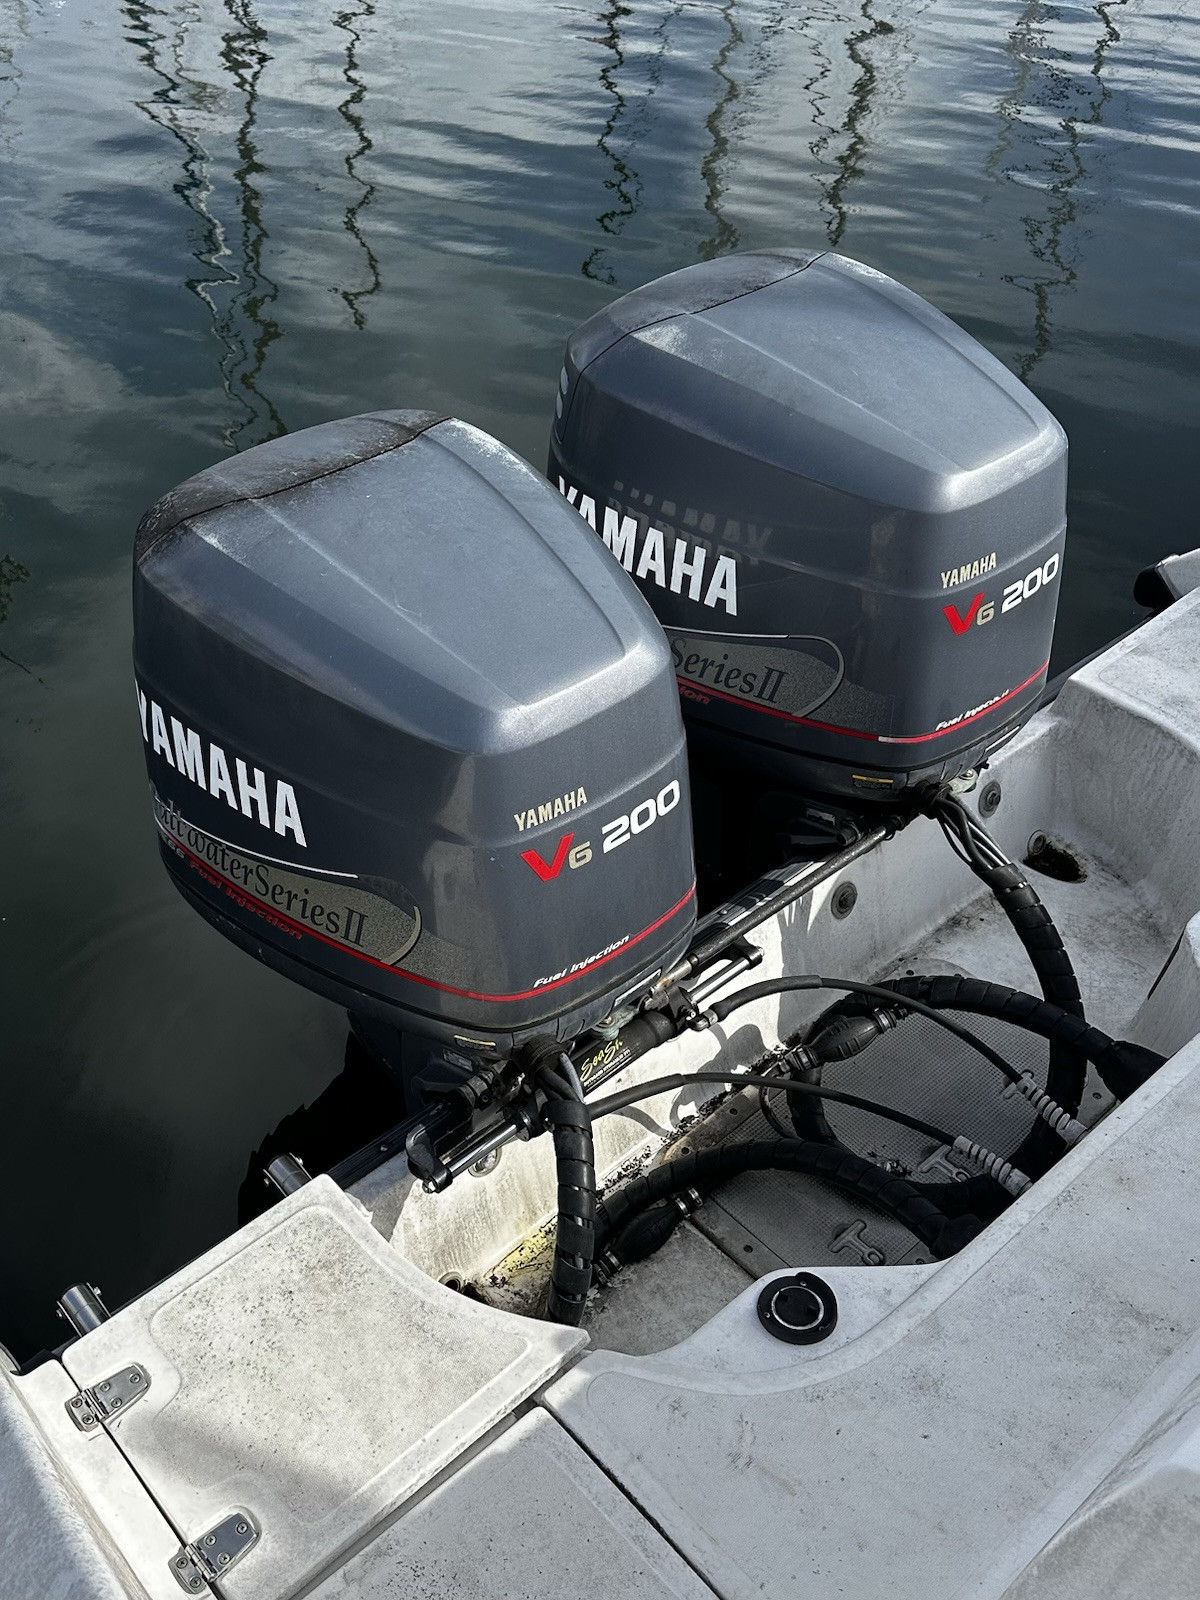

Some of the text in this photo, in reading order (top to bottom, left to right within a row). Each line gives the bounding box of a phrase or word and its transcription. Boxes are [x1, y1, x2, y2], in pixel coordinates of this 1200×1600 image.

[940, 552, 997, 589] YAMAHA
[942, 552, 1060, 635] V6 200
[134, 679, 308, 849] YAMAHA
[513, 786, 588, 832] YAMAHA
[520, 779, 681, 882] V6 200
[533, 934, 631, 989] Fuel Injection
